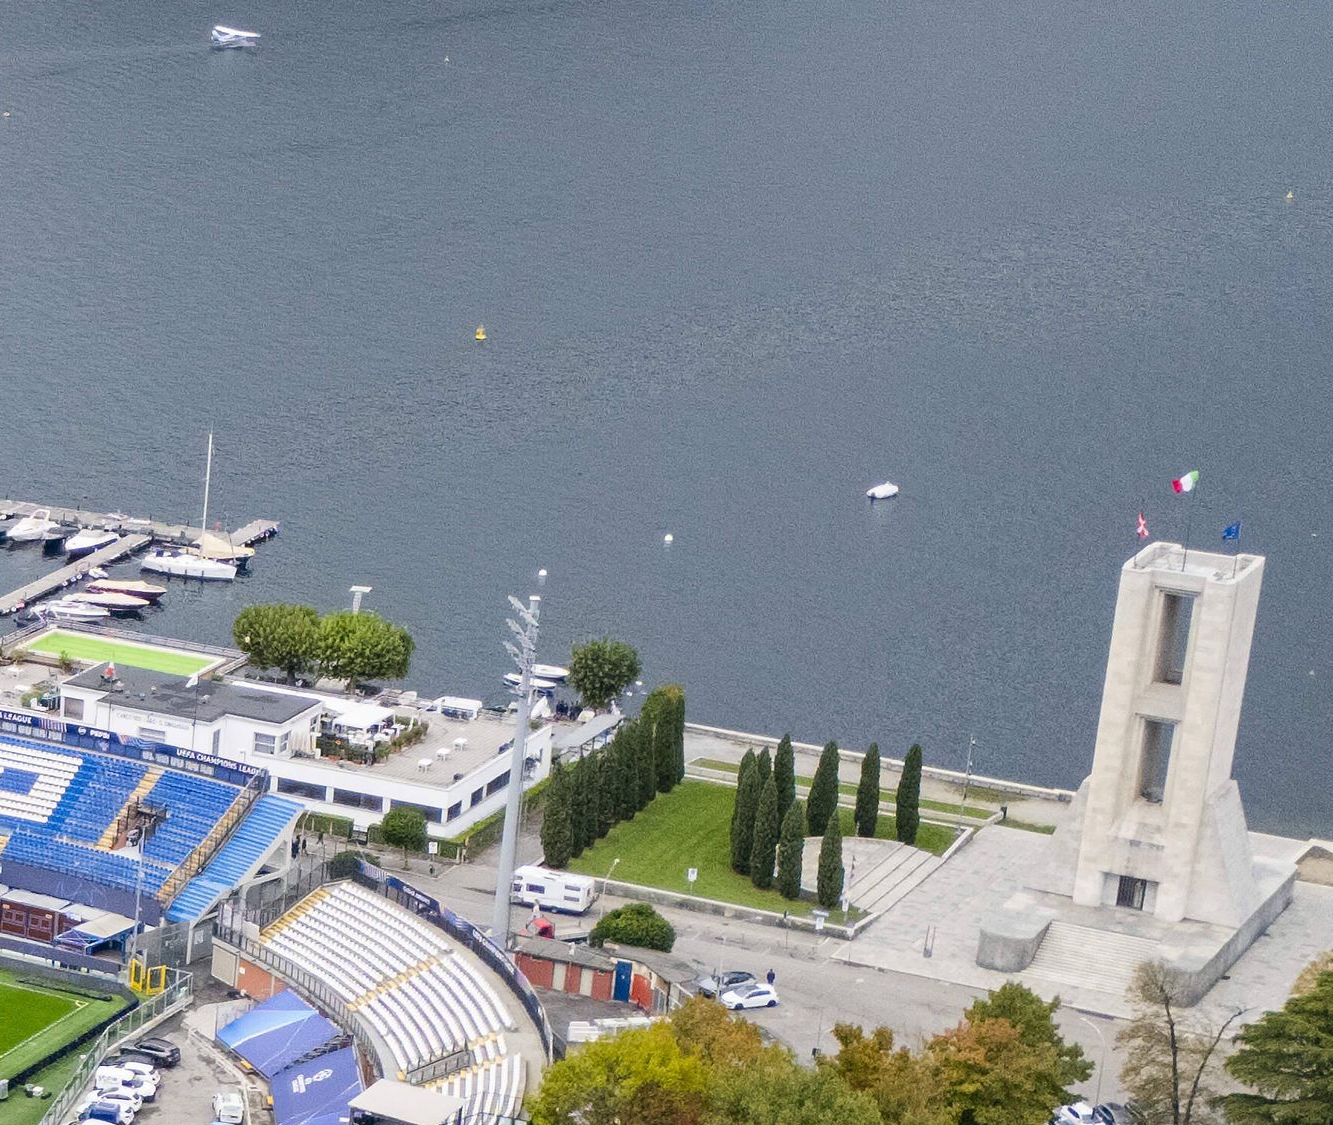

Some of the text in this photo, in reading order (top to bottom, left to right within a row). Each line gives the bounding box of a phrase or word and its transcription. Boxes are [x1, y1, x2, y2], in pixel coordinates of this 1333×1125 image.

[4, 712, 33, 724] LEAGUE
[176, 748, 196, 759] UEFA
[196, 753, 238, 770] CHAMPIONS
